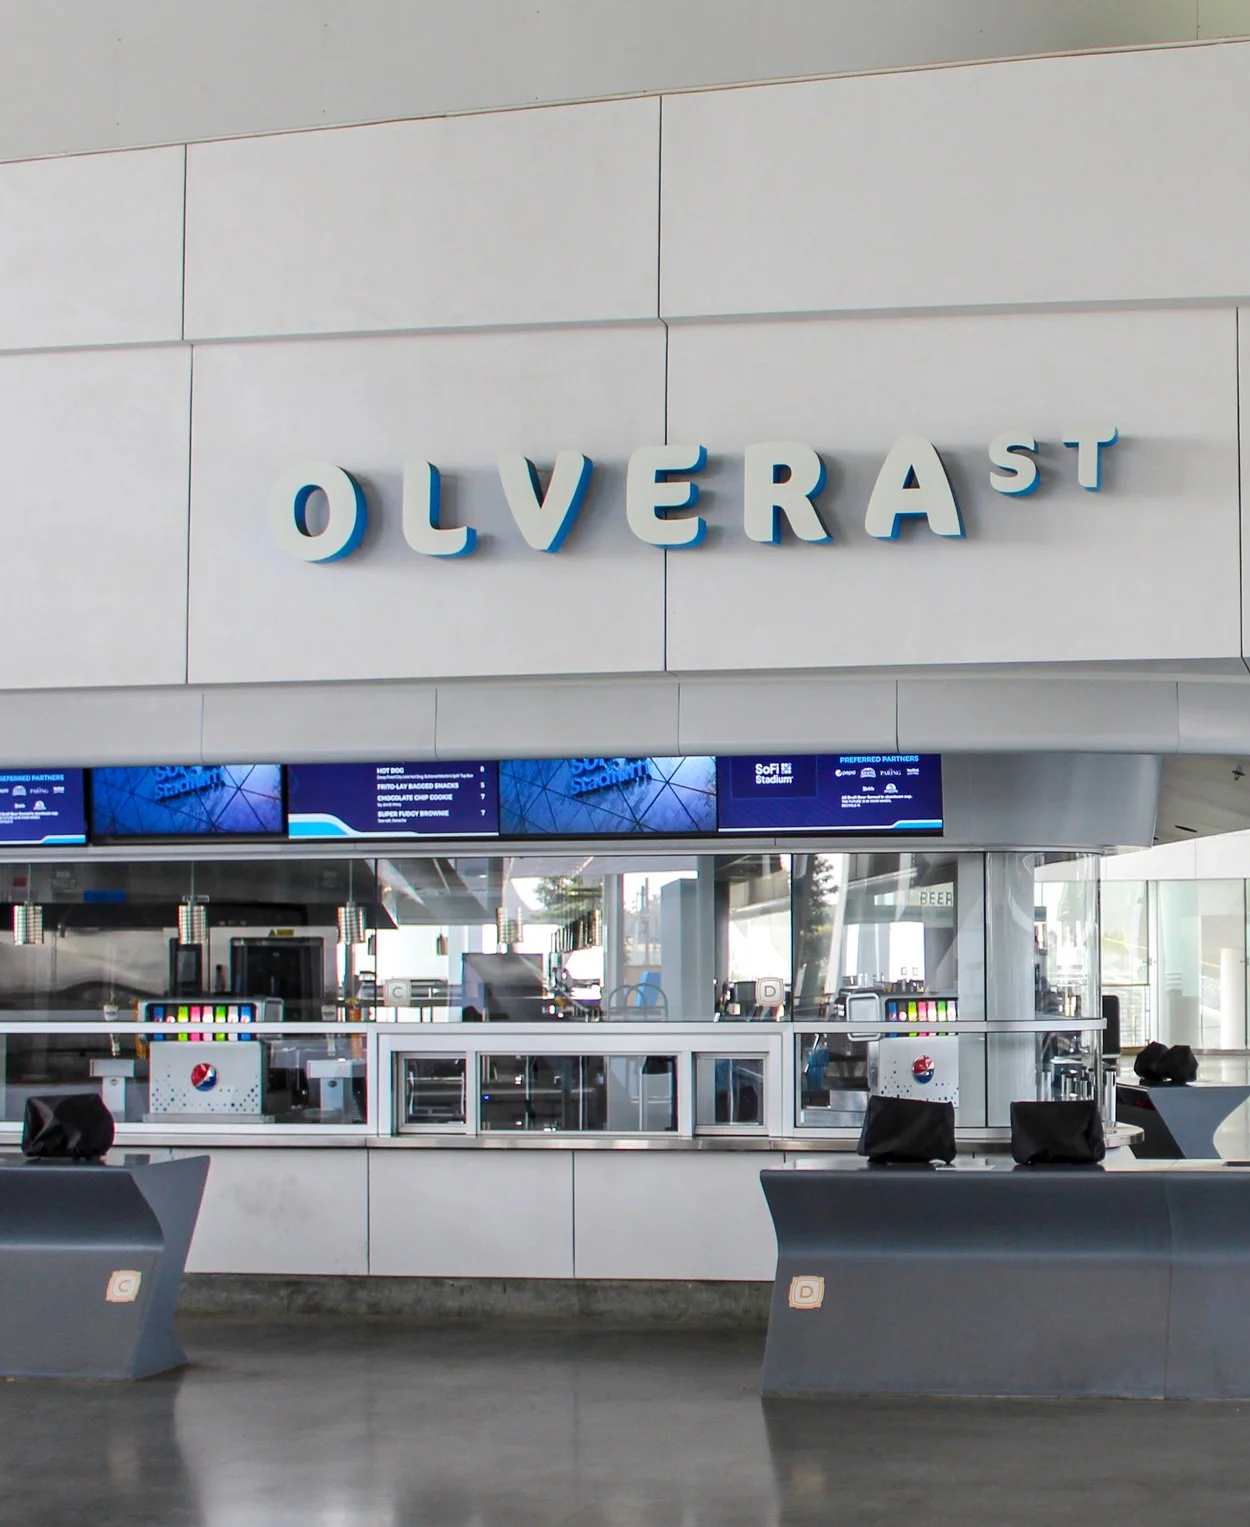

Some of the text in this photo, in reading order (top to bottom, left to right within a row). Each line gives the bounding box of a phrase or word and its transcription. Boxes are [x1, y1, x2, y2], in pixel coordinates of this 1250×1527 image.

[270, 426, 1119, 564] OLVERA ST
[882, 755, 919, 763] PARTNERS
[755, 763, 780, 775] SoFi
[755, 774, 793, 785] Stadium
[408, 782, 434, 790] BAGGED
[377, 794, 413, 802] CHOCOLATE
[377, 810, 398, 818] SUPER
[920, 891, 953, 905] BEER
[764, 985, 776, 998] D
[118, 1279, 130, 1293] C
[800, 1285, 814, 1299] D
